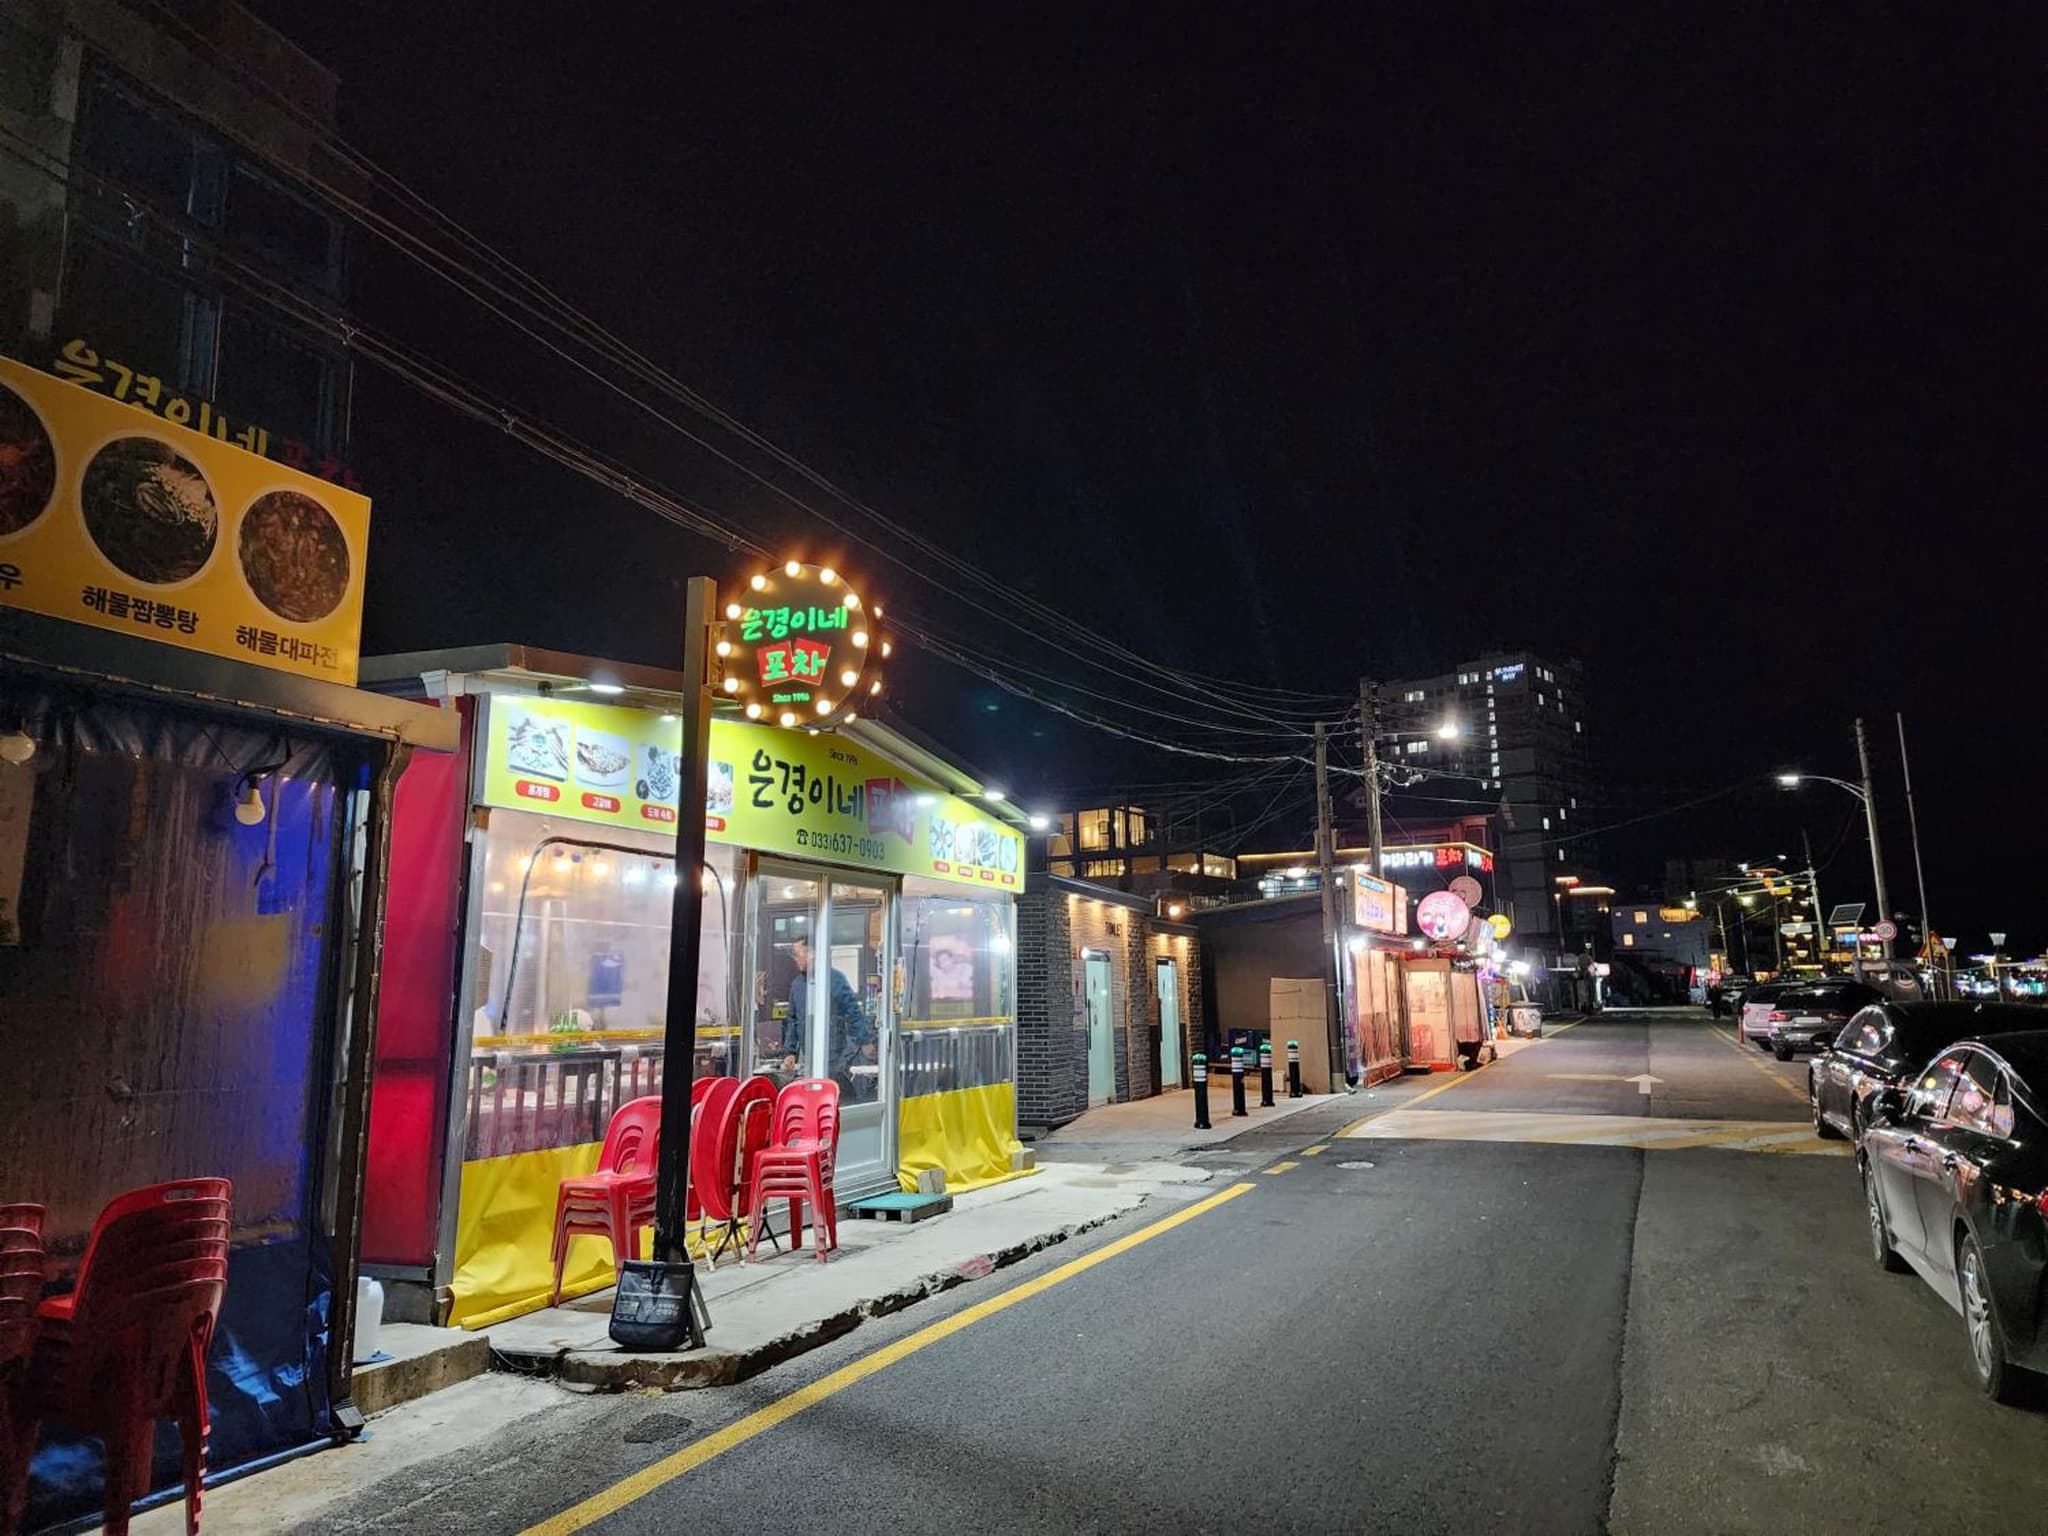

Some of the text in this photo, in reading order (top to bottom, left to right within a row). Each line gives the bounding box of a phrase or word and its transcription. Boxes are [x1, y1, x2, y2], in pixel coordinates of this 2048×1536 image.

[55, 339, 269, 457] 은경이네
[81, 585, 199, 635] 해물짬뽕탕
[740, 605, 849, 641] 은경이네
[235, 625, 340, 670] 해물대파전
[762, 648, 827, 681] 포차
[748, 749, 865, 823] 은경이네
